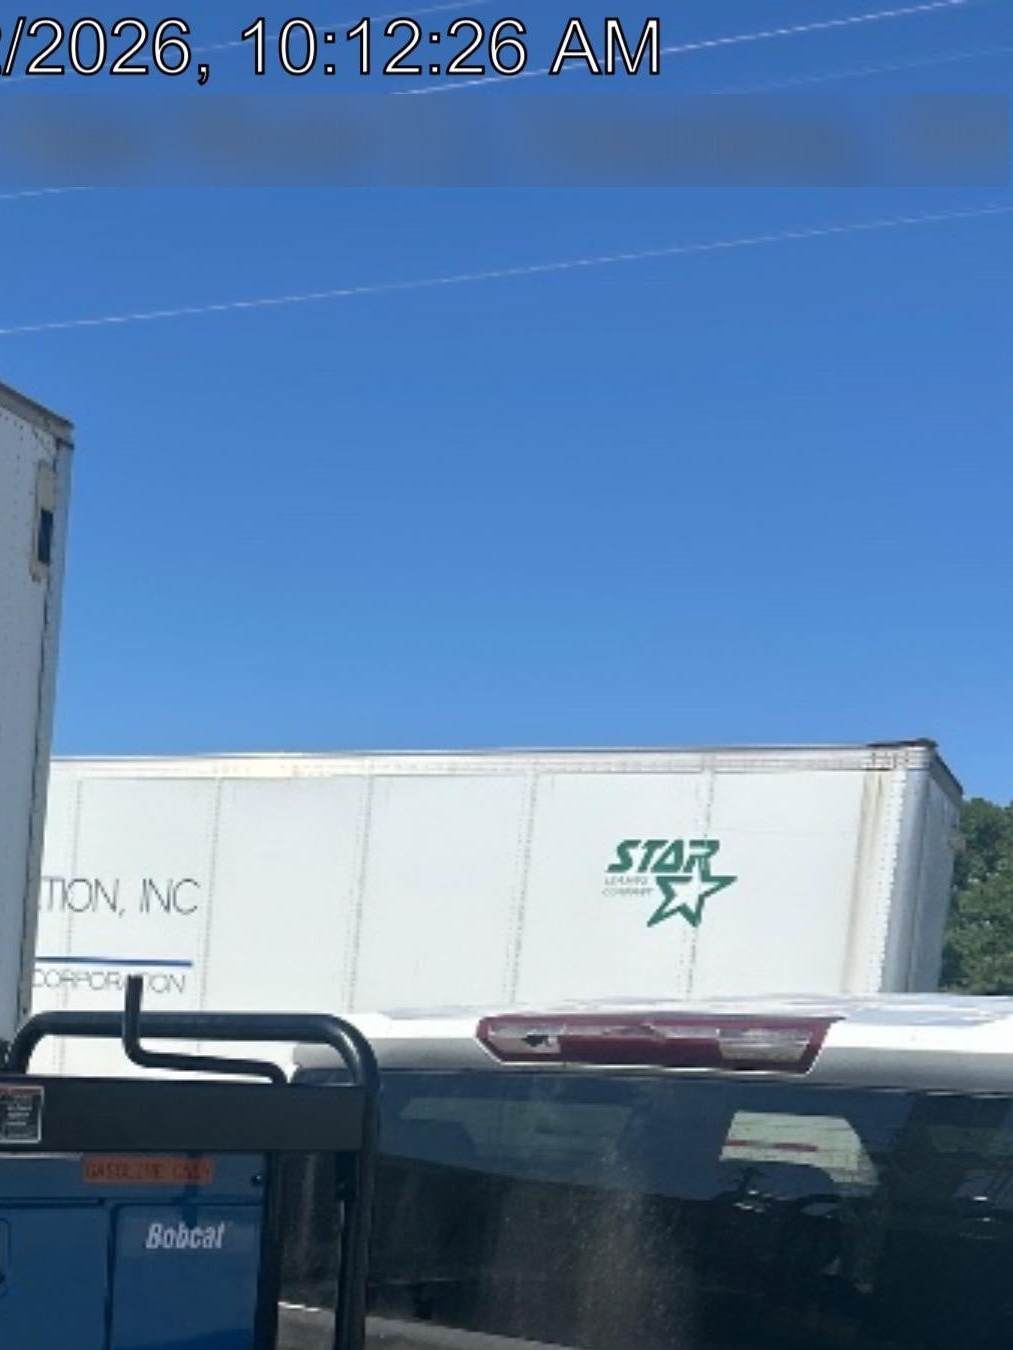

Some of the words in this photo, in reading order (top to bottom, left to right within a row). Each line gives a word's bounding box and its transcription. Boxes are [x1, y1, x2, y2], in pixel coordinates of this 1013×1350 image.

[605, 839, 720, 873] STAR
[39, 876, 126, 918] TION,
[139, 878, 200, 915] INC
[146, 1221, 226, 1249] Bobcat
